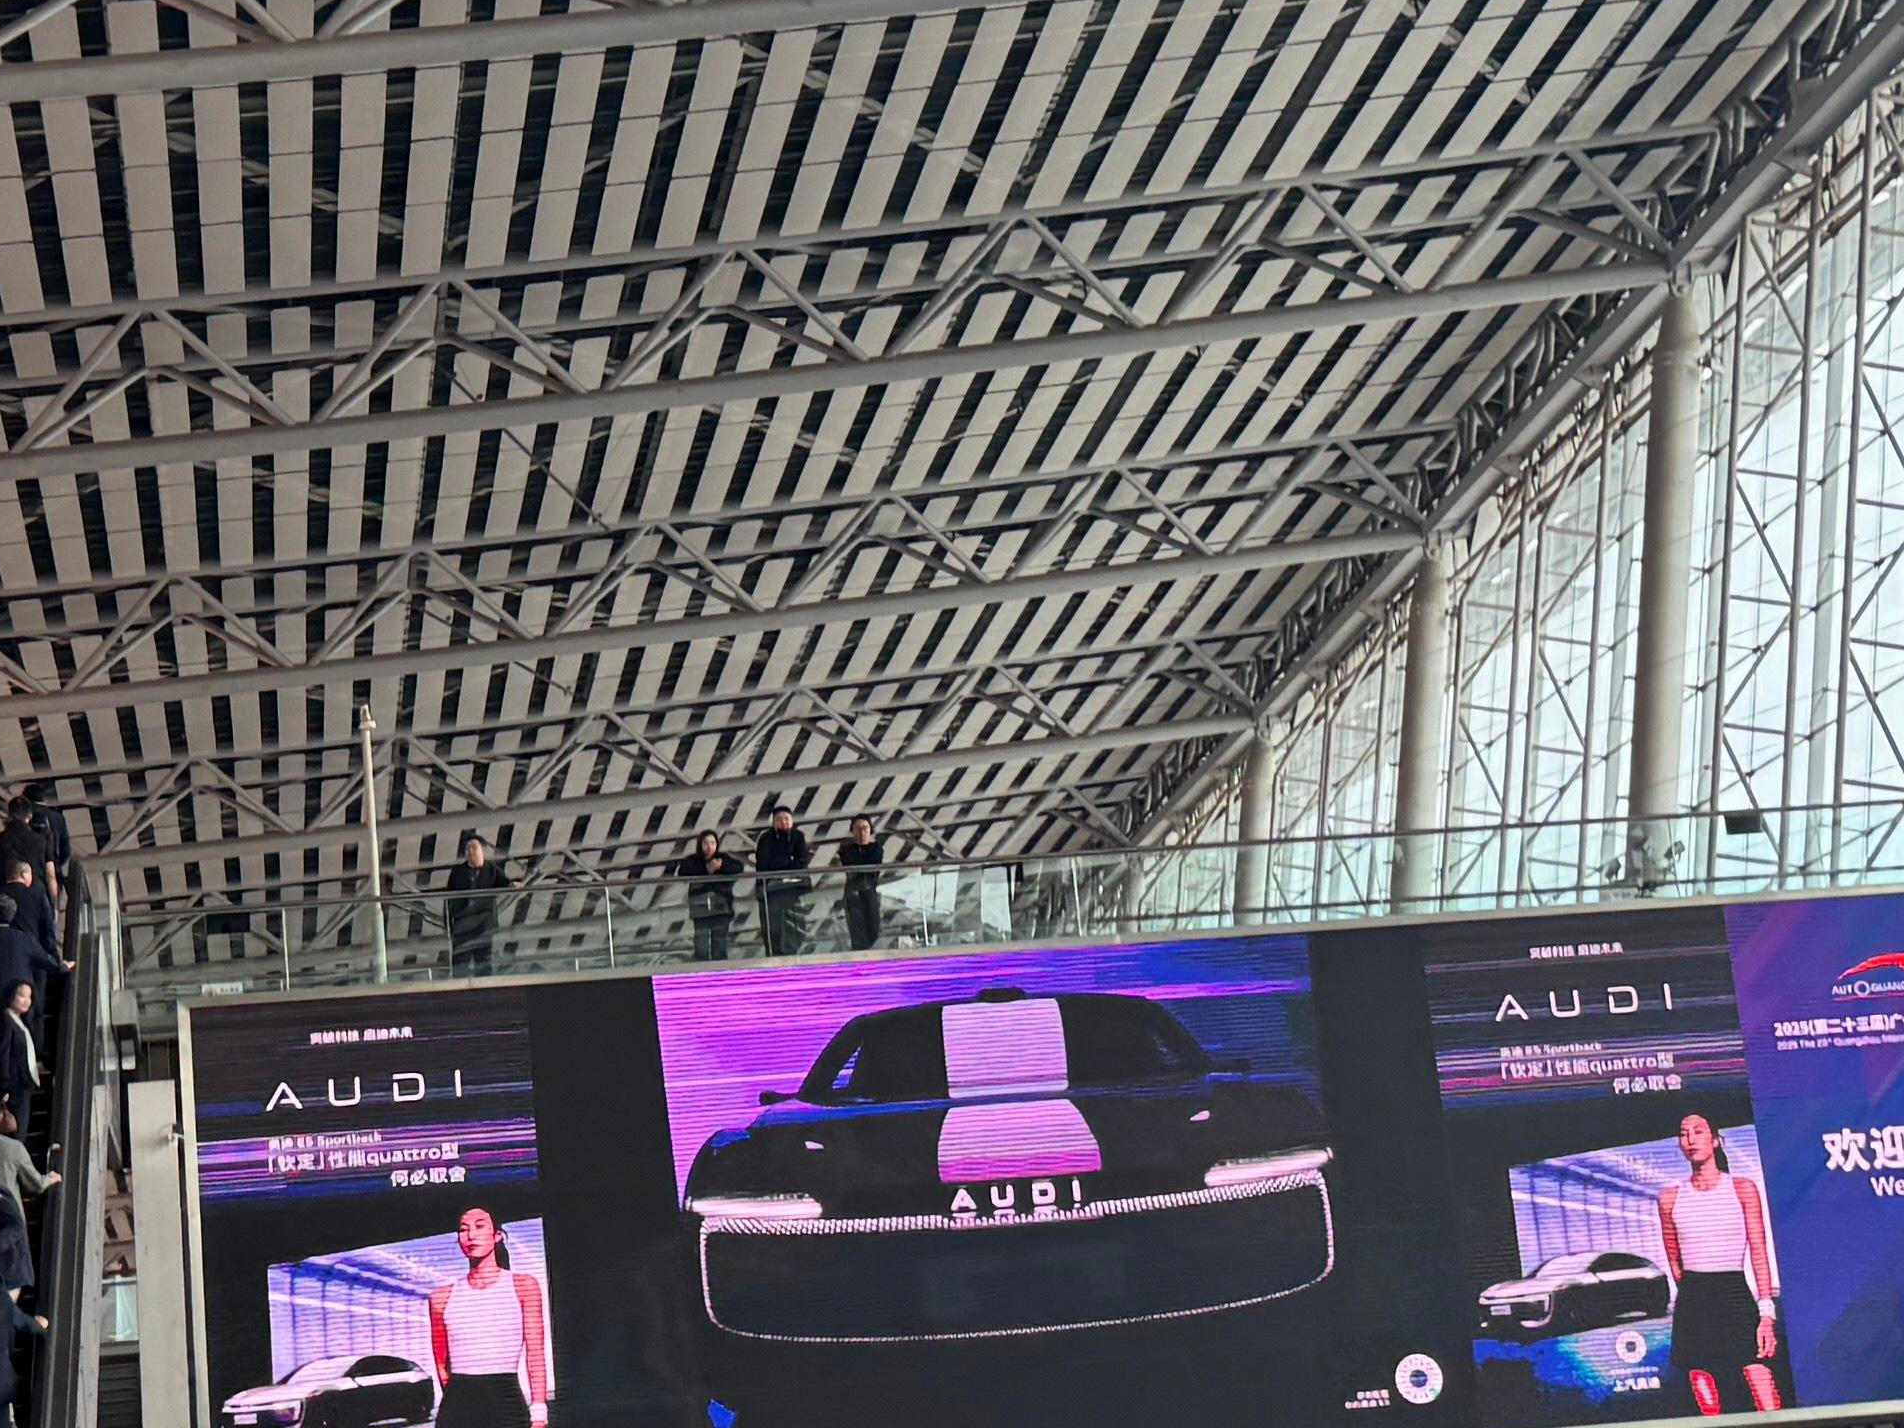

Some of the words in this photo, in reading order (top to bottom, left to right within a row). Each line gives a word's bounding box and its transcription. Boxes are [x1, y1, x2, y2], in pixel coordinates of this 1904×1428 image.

[1495, 982, 1673, 1022] AUDI
[265, 1069, 463, 1112] AUDI
[950, 1178, 1082, 1212] AUDI
